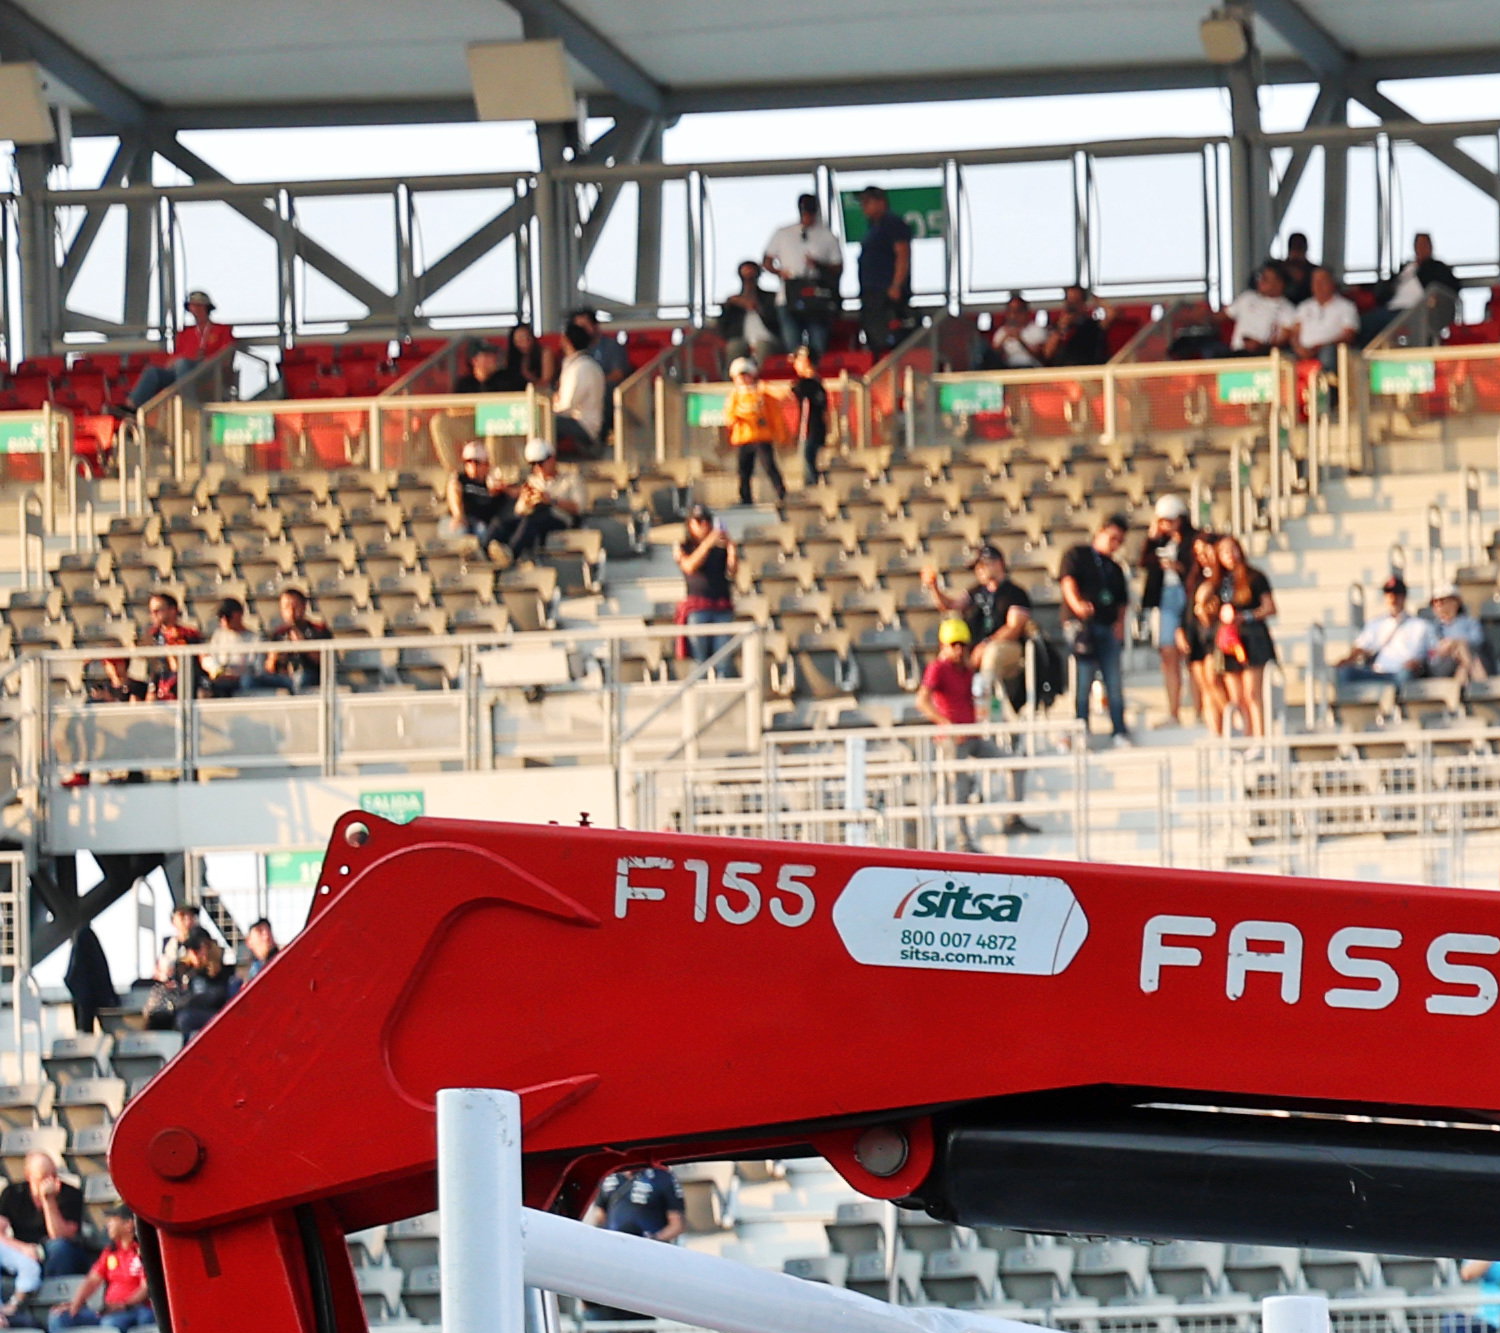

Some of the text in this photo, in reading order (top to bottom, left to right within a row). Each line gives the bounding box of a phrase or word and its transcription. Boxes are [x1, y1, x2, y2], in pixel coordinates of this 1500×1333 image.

[613, 855, 817, 928] F155
[912, 880, 1024, 923] sitsa
[900, 929, 1018, 951] 800 007 4872
[900, 946, 1016, 967] sitsa.com.mx
